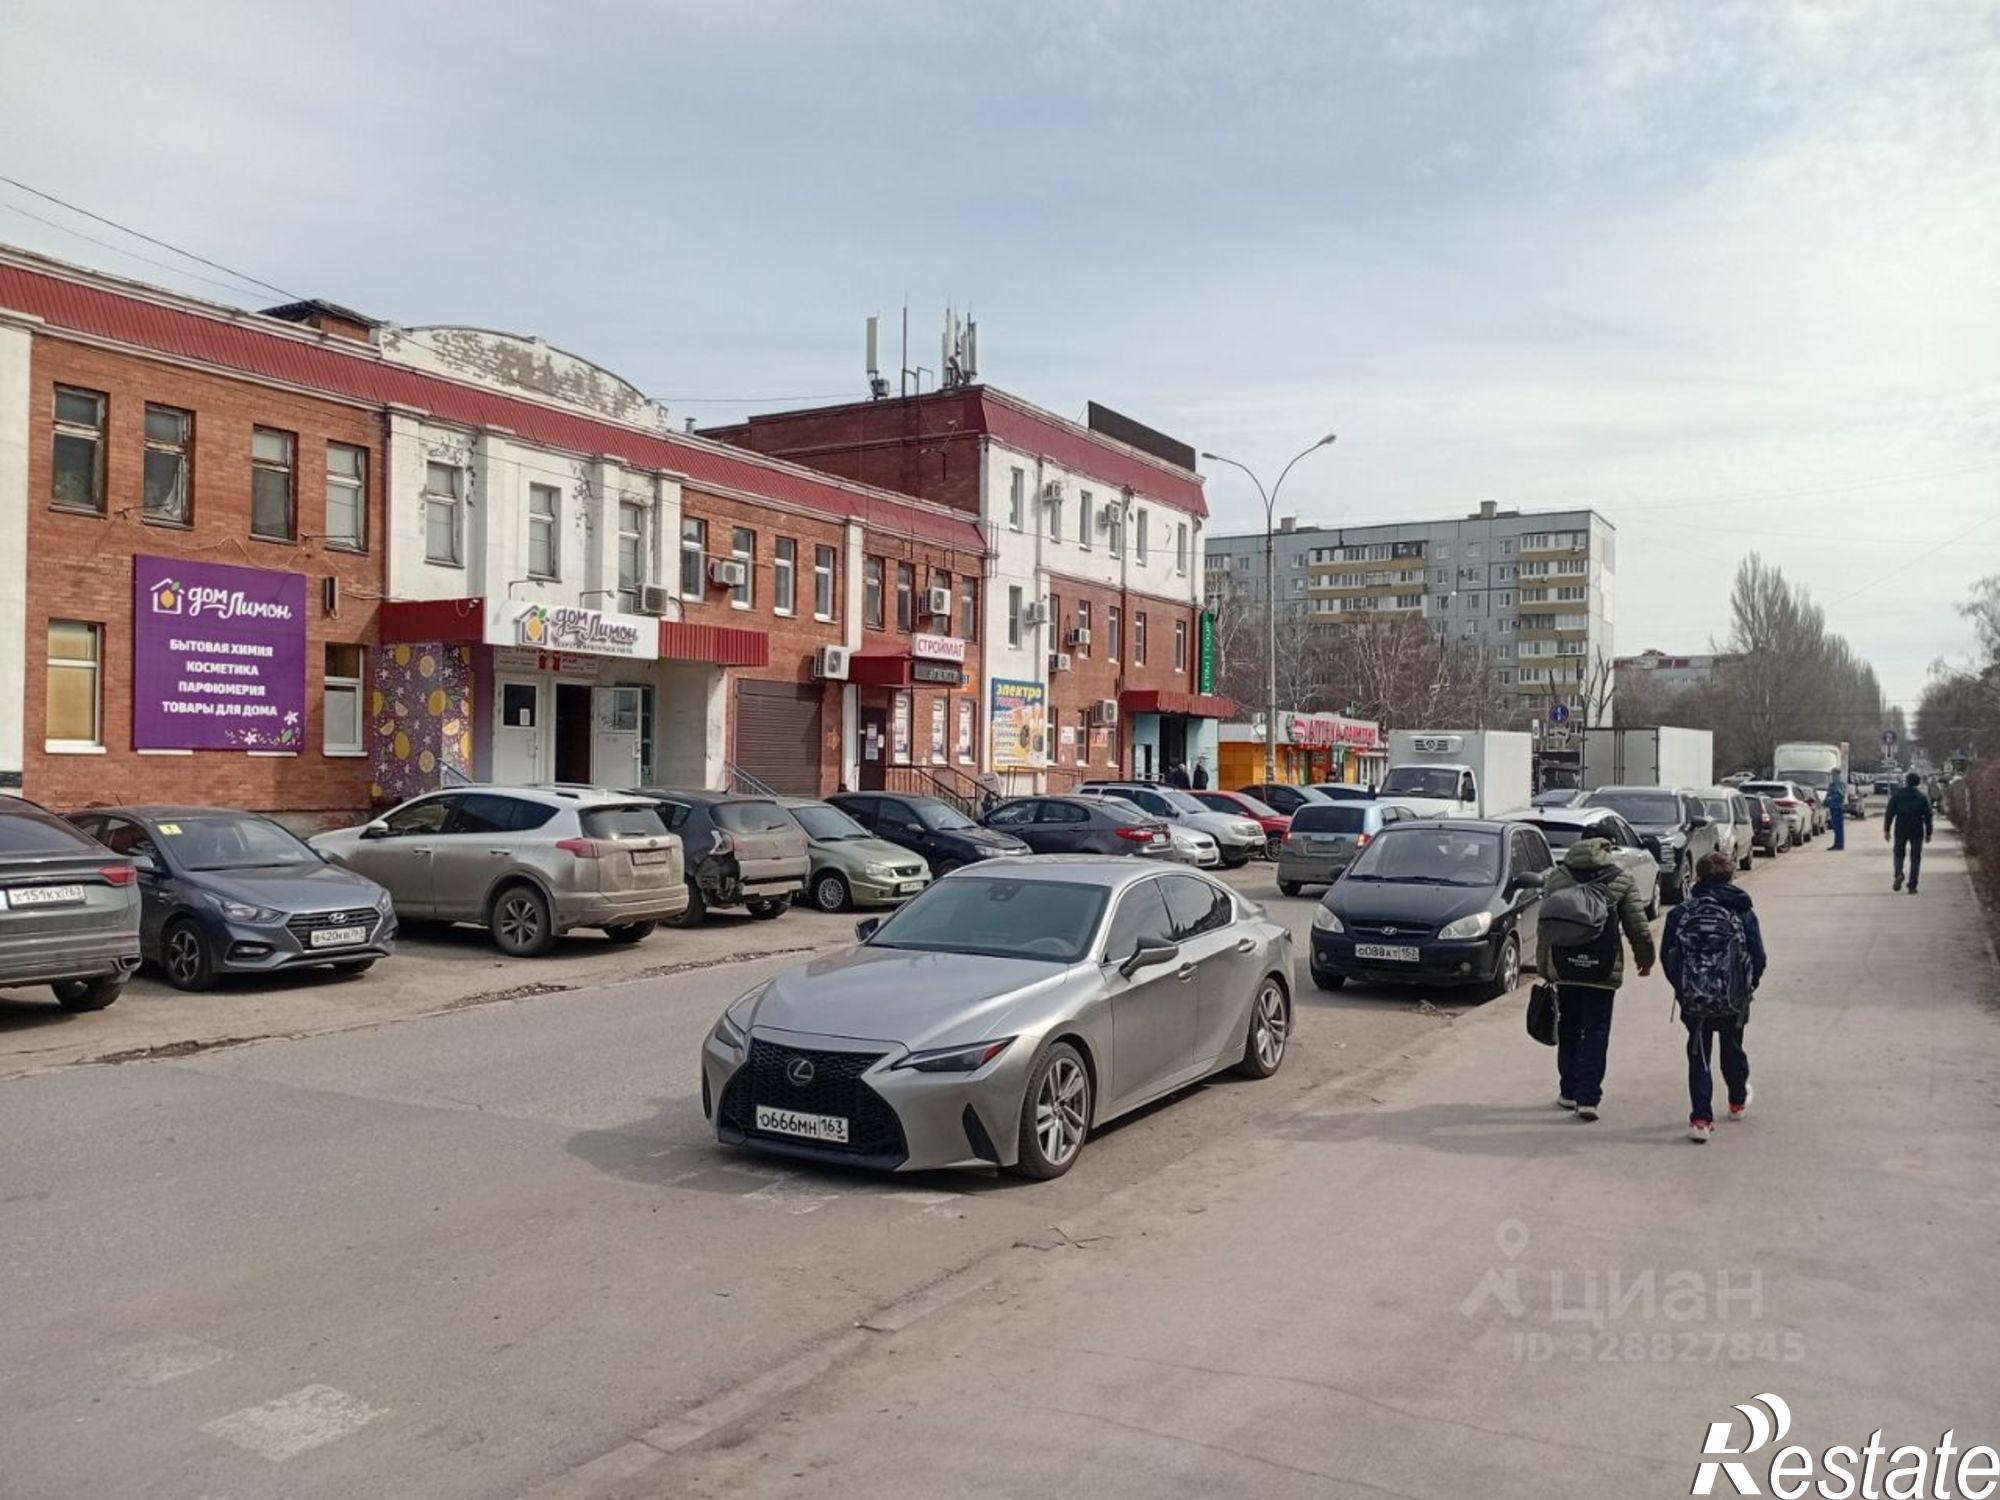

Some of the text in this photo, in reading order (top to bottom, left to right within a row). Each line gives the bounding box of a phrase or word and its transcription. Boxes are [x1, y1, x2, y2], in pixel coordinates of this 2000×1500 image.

[218, 592, 292, 619] Лимон
[581, 614, 638, 641] Лимон
[169, 638, 273, 657] БЫТОВАЯ ХИМИЯ
[918, 639, 963, 657] СТРОЙМАГ
[186, 660, 259, 676] КОСМЕТИКА
[178, 681, 266, 696] ПАРФЮМЕРИЯ
[161, 700, 278, 717] ТОВАРЫ ДЛЯ ДОМА
[820, 1118, 843, 1134] 163
